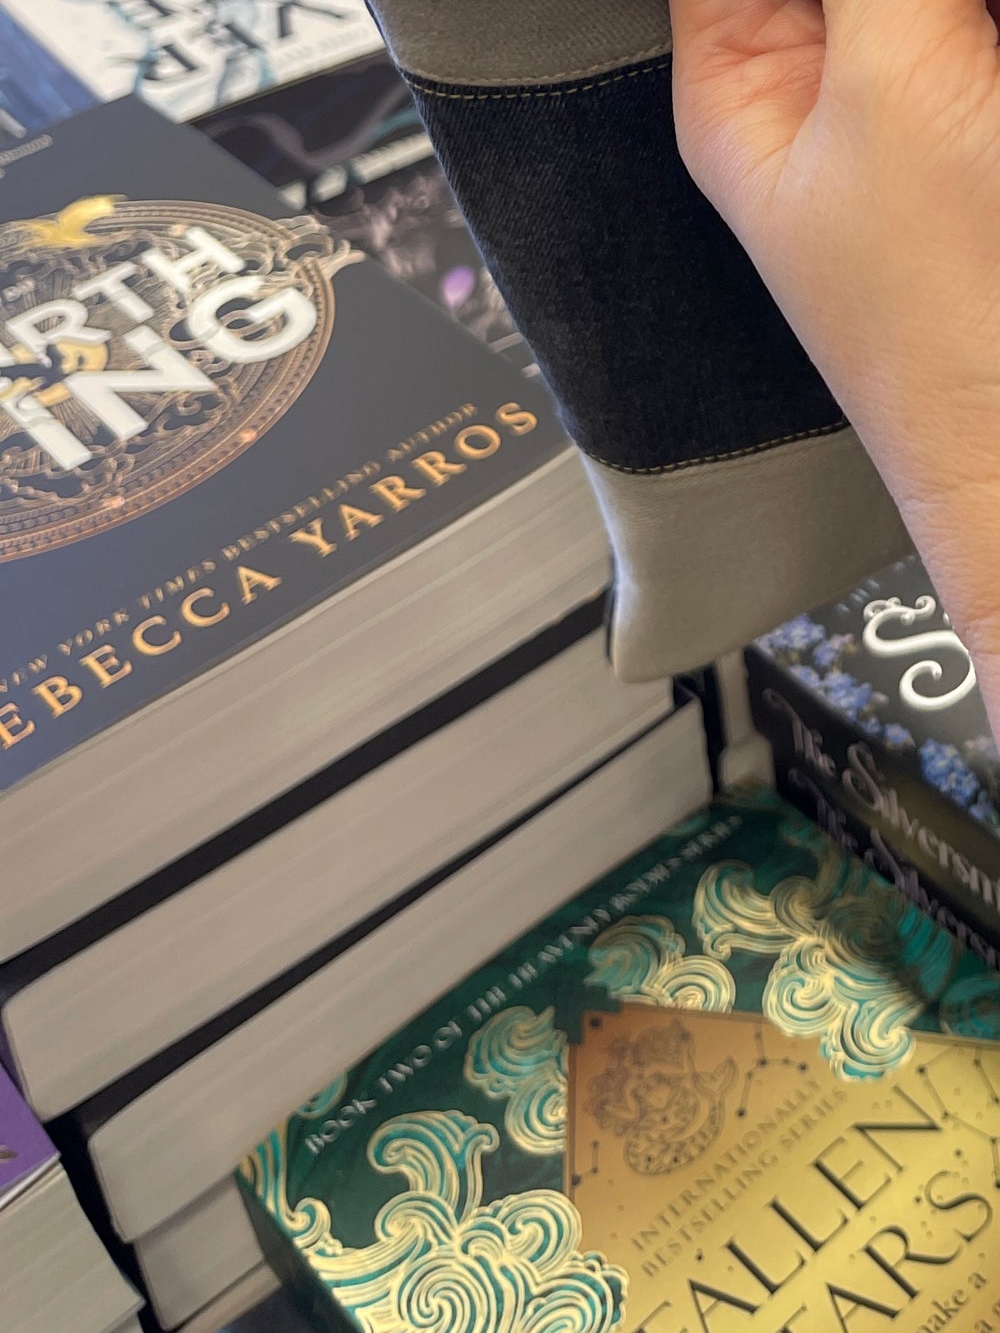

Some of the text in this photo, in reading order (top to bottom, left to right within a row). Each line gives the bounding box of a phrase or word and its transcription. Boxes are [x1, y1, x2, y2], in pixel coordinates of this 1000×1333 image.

[0, 274, 318, 471] ING
[57, 606, 130, 657] YORK
[138, 559, 217, 610] TIMES
[222, 461, 381, 562] BESTSELLING
[387, 402, 478, 463] AUTHOR
[288, 401, 538, 558] YARROS
[304, 1098, 378, 1155] BOOK
[378, 1044, 433, 1093] TWO
[631, 1079, 821, 1252] INTERNATIONALLY
[641, 1149, 779, 1277] BESTSELLING
[967, 1271, 987, 1291] a
